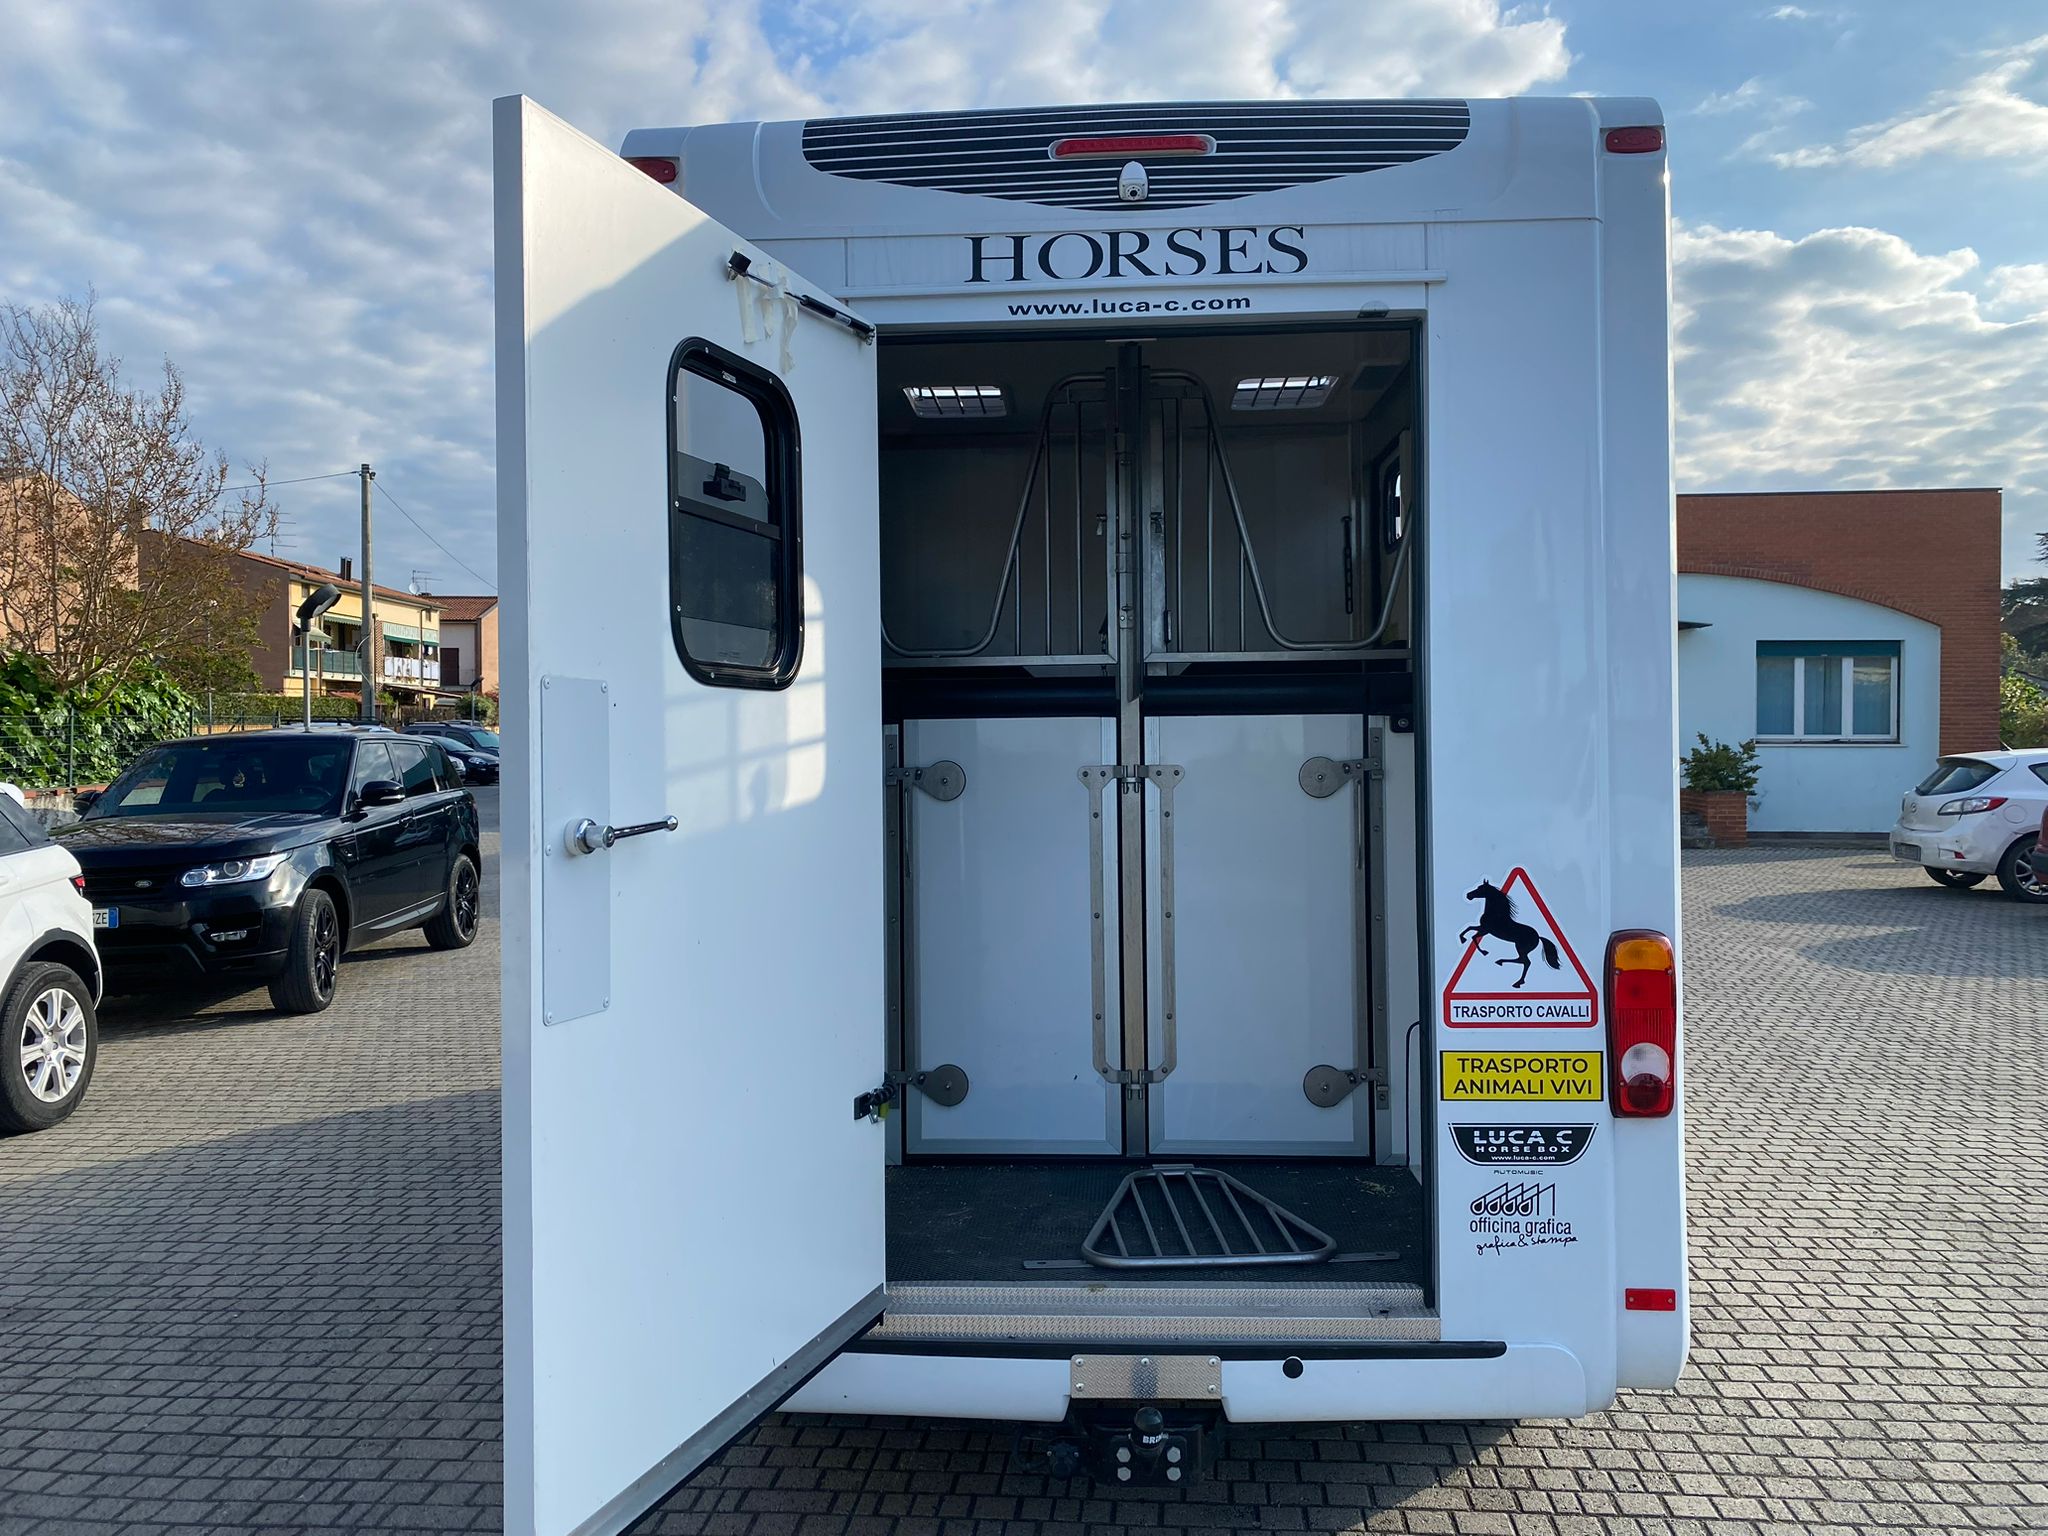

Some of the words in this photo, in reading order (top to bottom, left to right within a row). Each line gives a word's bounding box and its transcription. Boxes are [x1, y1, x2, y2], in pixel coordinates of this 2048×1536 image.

[963, 226, 1309, 283] HORSES
[1007, 296, 1251, 317] www.luca-c.com
[92, 912, 107, 925] ZE
[1453, 1005, 1533, 1018] TRASPORTO
[1536, 1005, 1590, 1018] CAVALLI
[1457, 1057, 1589, 1074] TRASPORTO
[1453, 1078, 1544, 1095] ANIMALI
[1551, 1078, 1592, 1095] VIVI
[1473, 1130, 1546, 1145] LUCA
[1556, 1130, 1573, 1145] C
[1475, 1145, 1531, 1153] HORSE
[1537, 1145, 1570, 1153] BOX
[1469, 1217, 1521, 1233] officina
[1525, 1218, 1572, 1237] grafica
